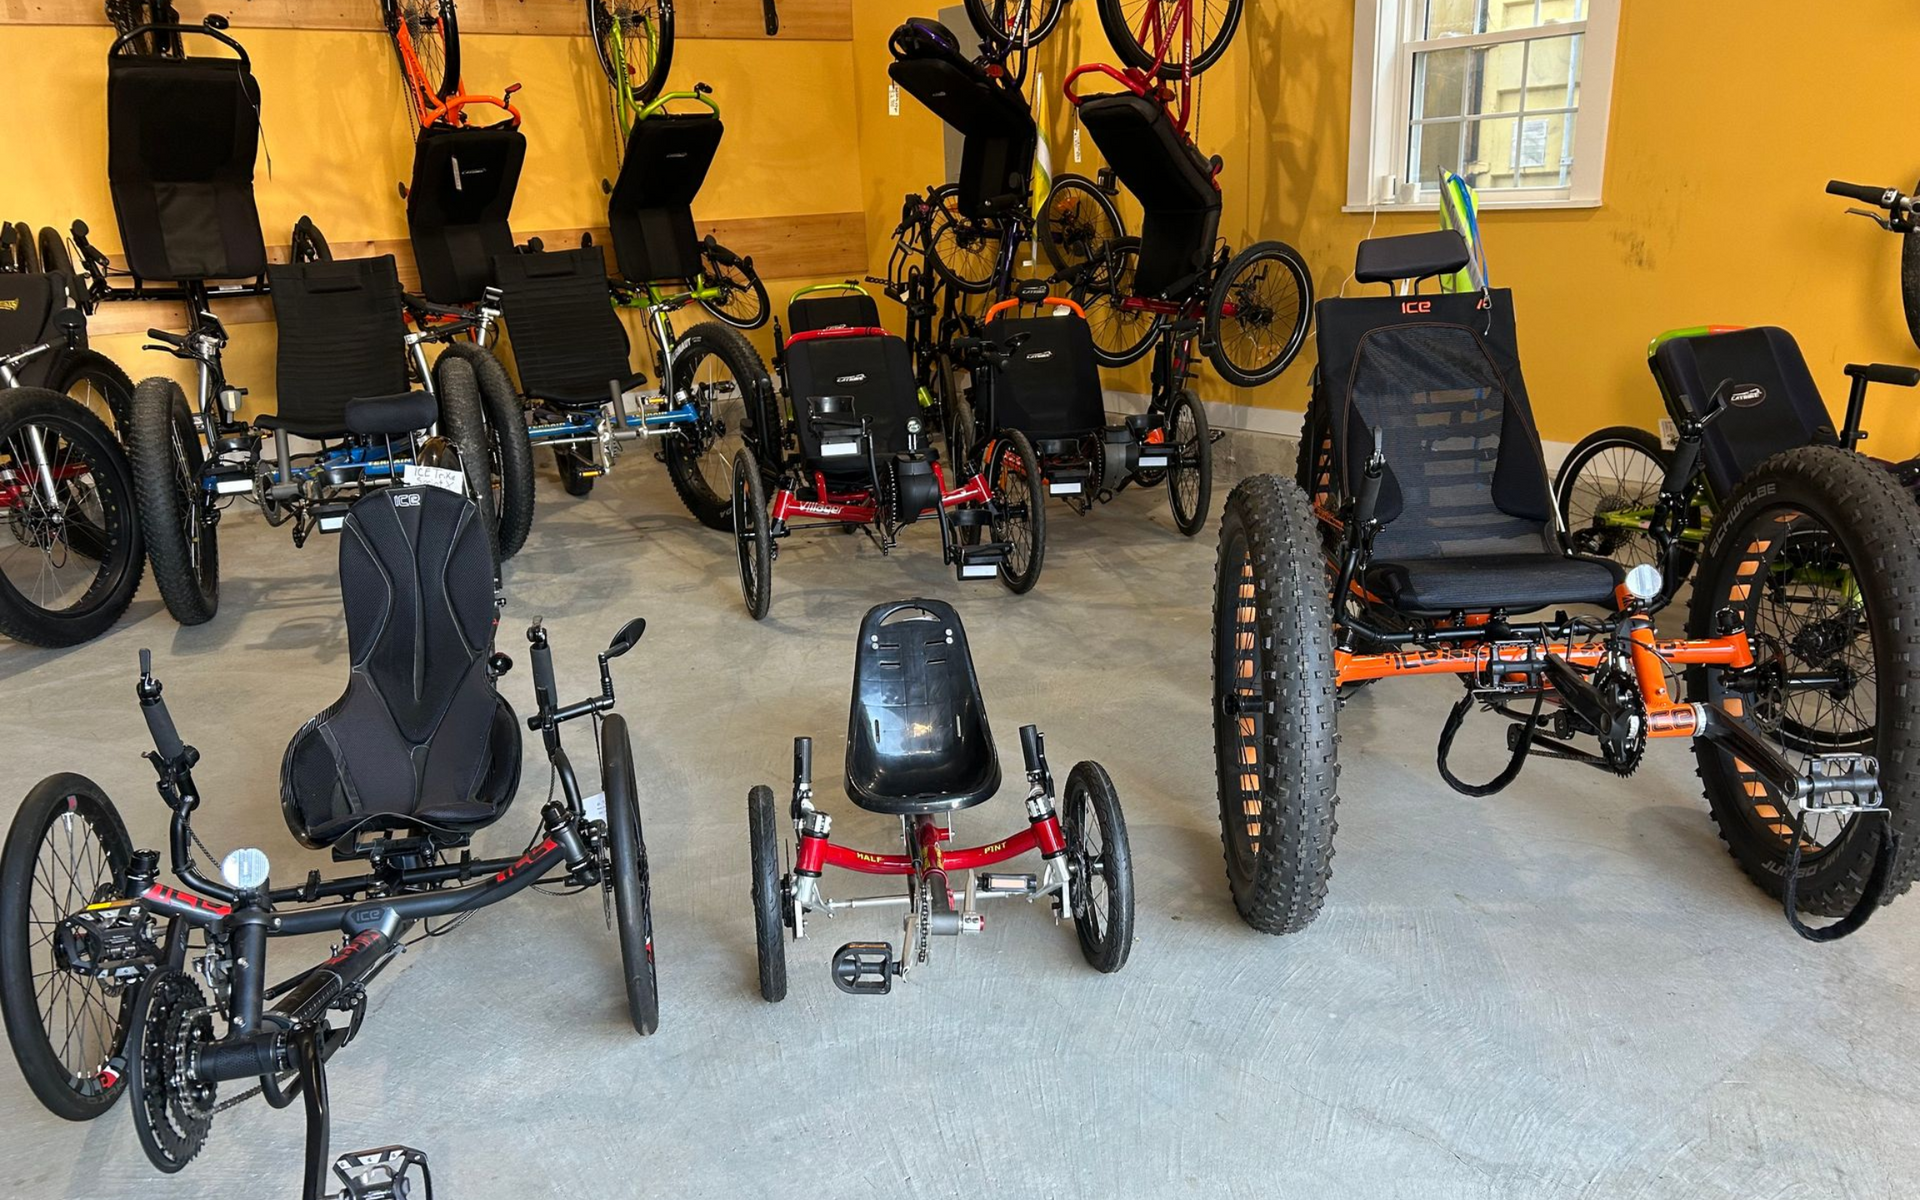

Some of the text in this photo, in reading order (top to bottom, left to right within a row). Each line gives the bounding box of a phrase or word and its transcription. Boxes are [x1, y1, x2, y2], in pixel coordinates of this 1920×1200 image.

[414, 467, 431, 477] ICE
[1709, 483, 1776, 557] SCHWALBE
[984, 841, 1007, 854] PINT
[856, 852, 884, 863] HALF
